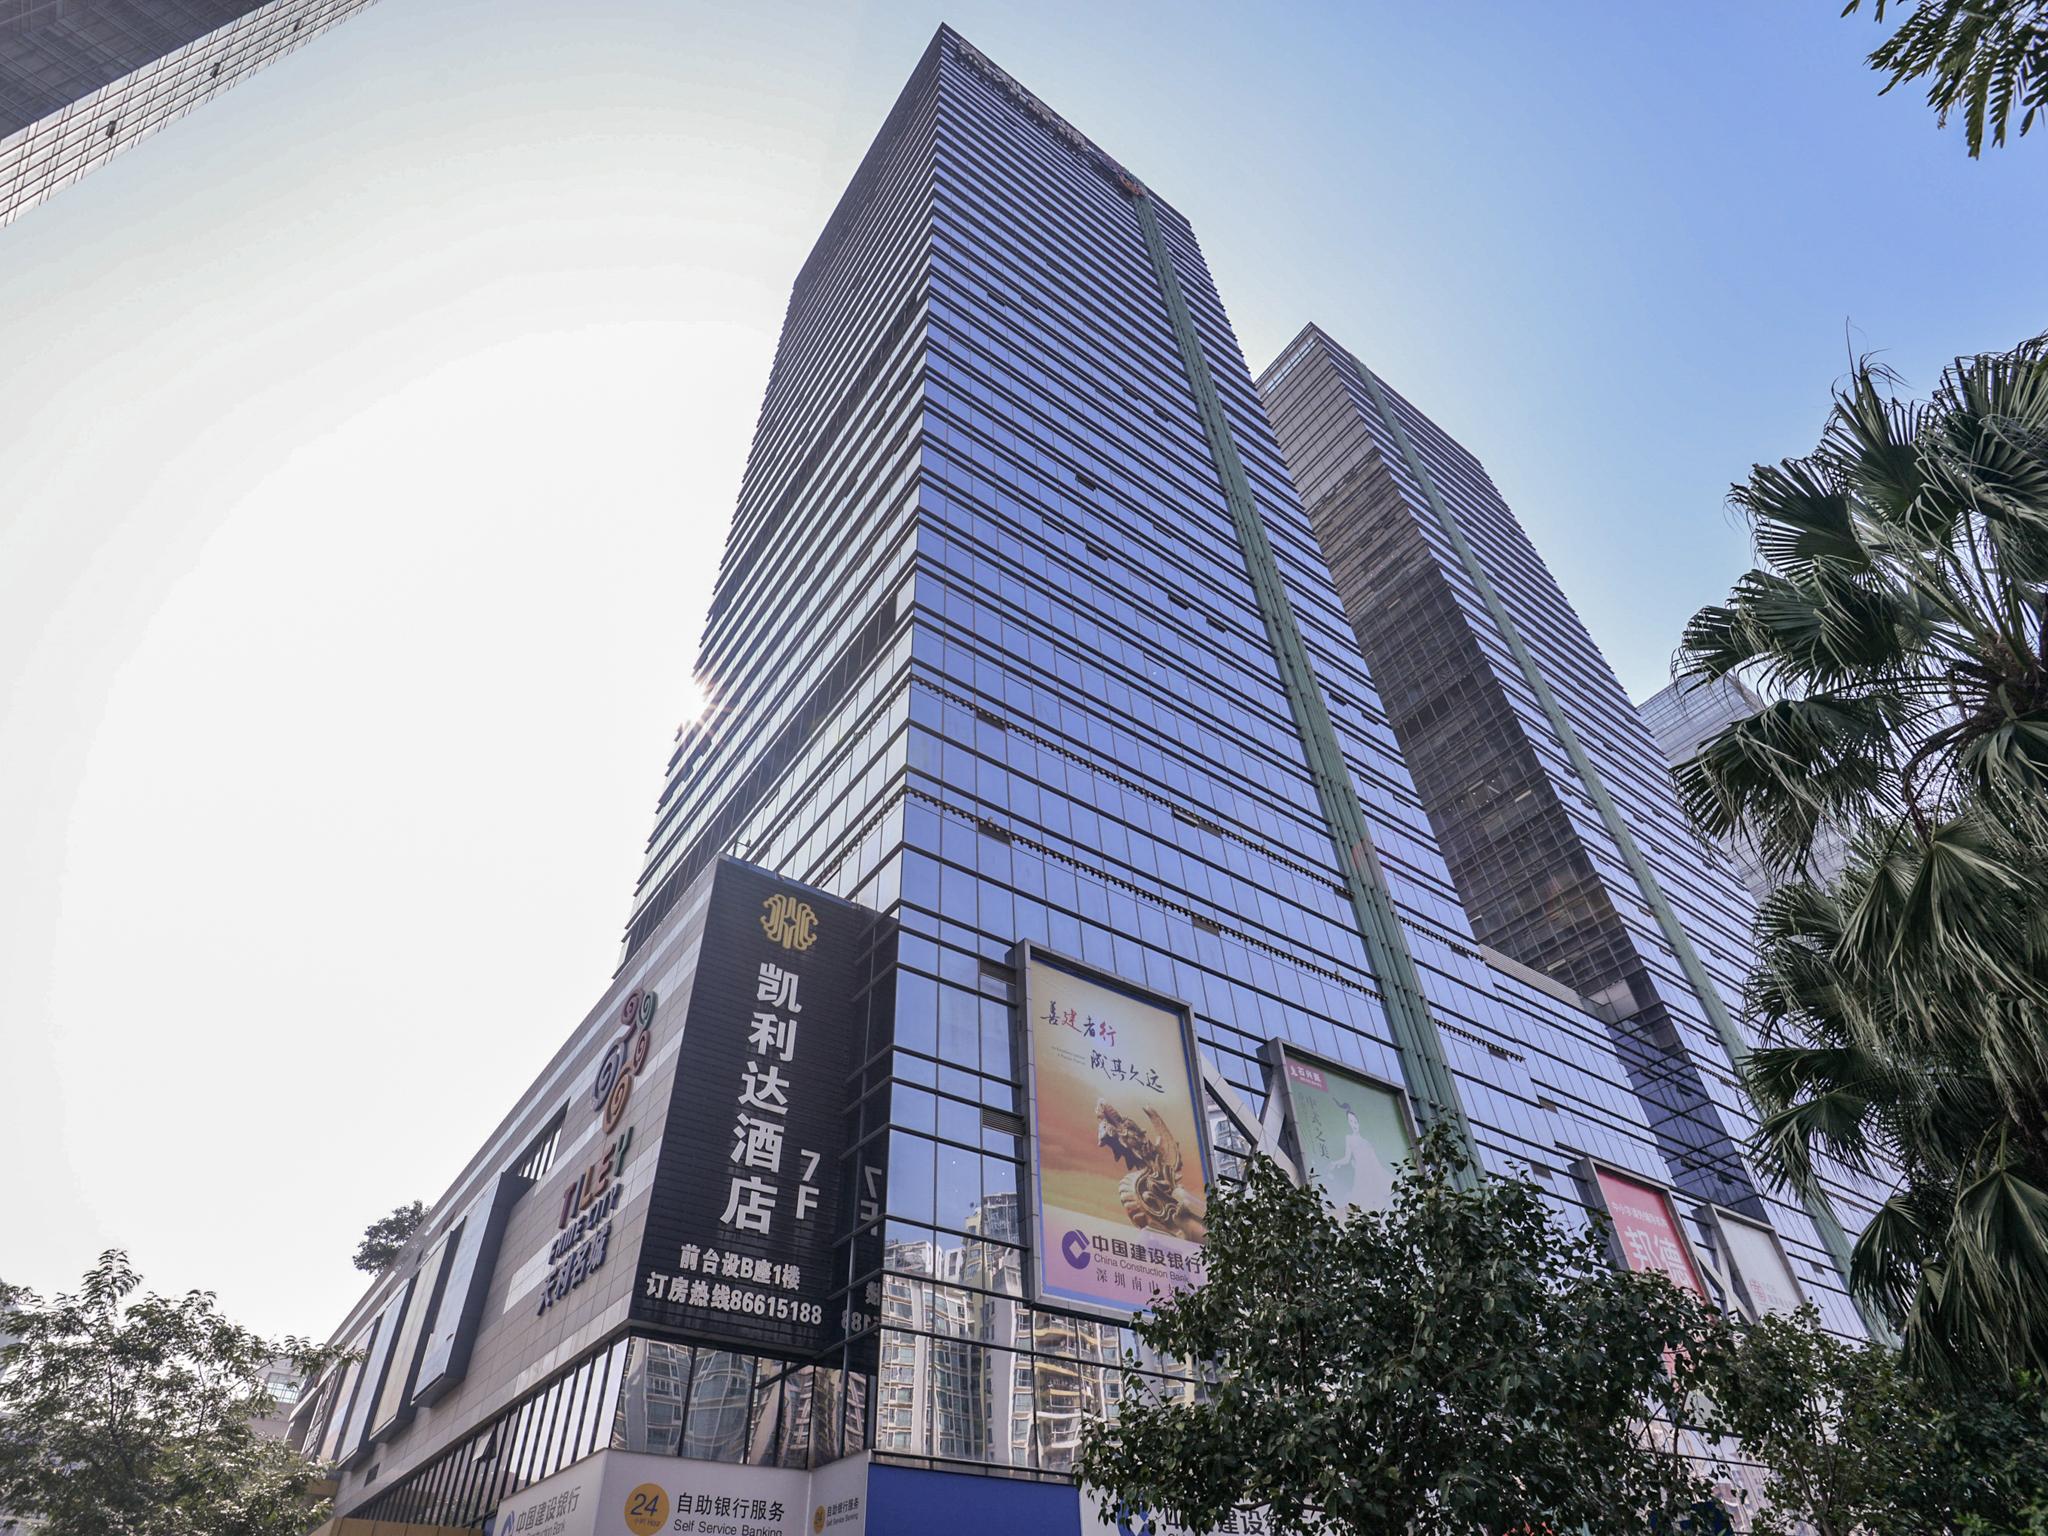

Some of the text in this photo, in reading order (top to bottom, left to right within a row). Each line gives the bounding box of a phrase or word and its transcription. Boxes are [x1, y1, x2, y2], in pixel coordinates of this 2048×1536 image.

[1040, 1000, 1117, 1047] 善建者行
[719, 962, 803, 1235] 凯利达酒店
[558, 1126, 634, 1229] TILEY
[679, 1243, 801, 1291] 前台设B座1楼
[1092, 1235, 1201, 1274] 中国建设银行
[1094, 1253, 1118, 1267] China
[1119, 1260, 1168, 1279] Construction
[646, 1271, 822, 1325] 订房热线86615188
[516, 1486, 581, 1531] 中国建设银行
[631, 1493, 658, 1516] 24
[677, 1492, 785, 1522] 自助银行服务
[827, 1497, 859, 1517] 自助银行服务
[674, 1519, 783, 1536] Self Service Banking
